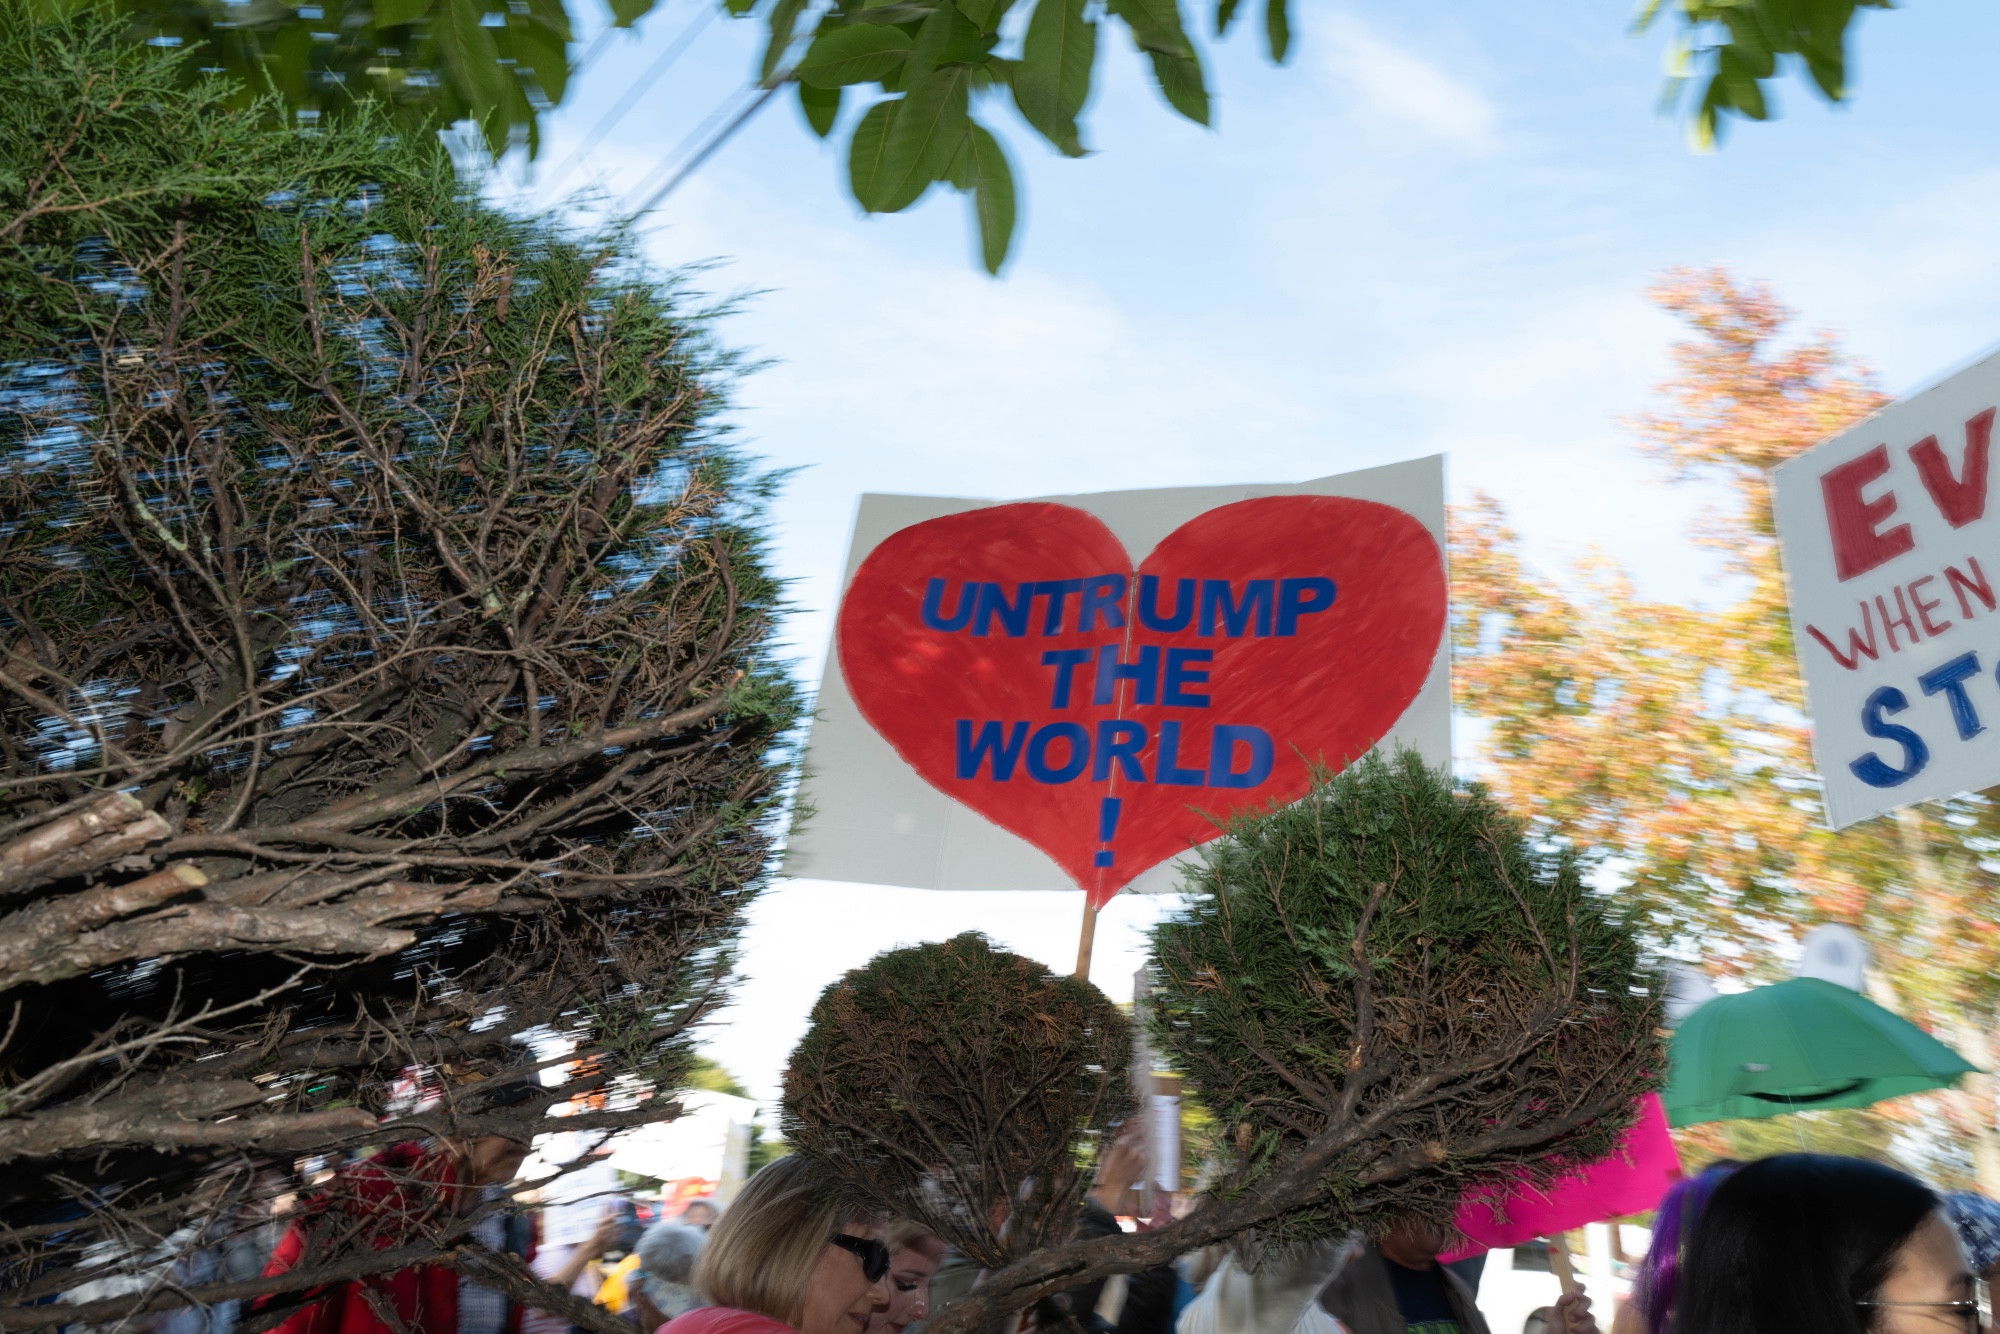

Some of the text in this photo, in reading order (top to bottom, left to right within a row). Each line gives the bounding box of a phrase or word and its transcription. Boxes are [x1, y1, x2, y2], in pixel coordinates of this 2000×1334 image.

[921, 572, 1339, 637] UNTRUMP
[1806, 556, 1997, 670] WHEN
[1041, 645, 1214, 709] THE
[954, 719, 1275, 789] WORLD
[1849, 650, 2000, 788] ST
[1094, 797, 1122, 868] !
